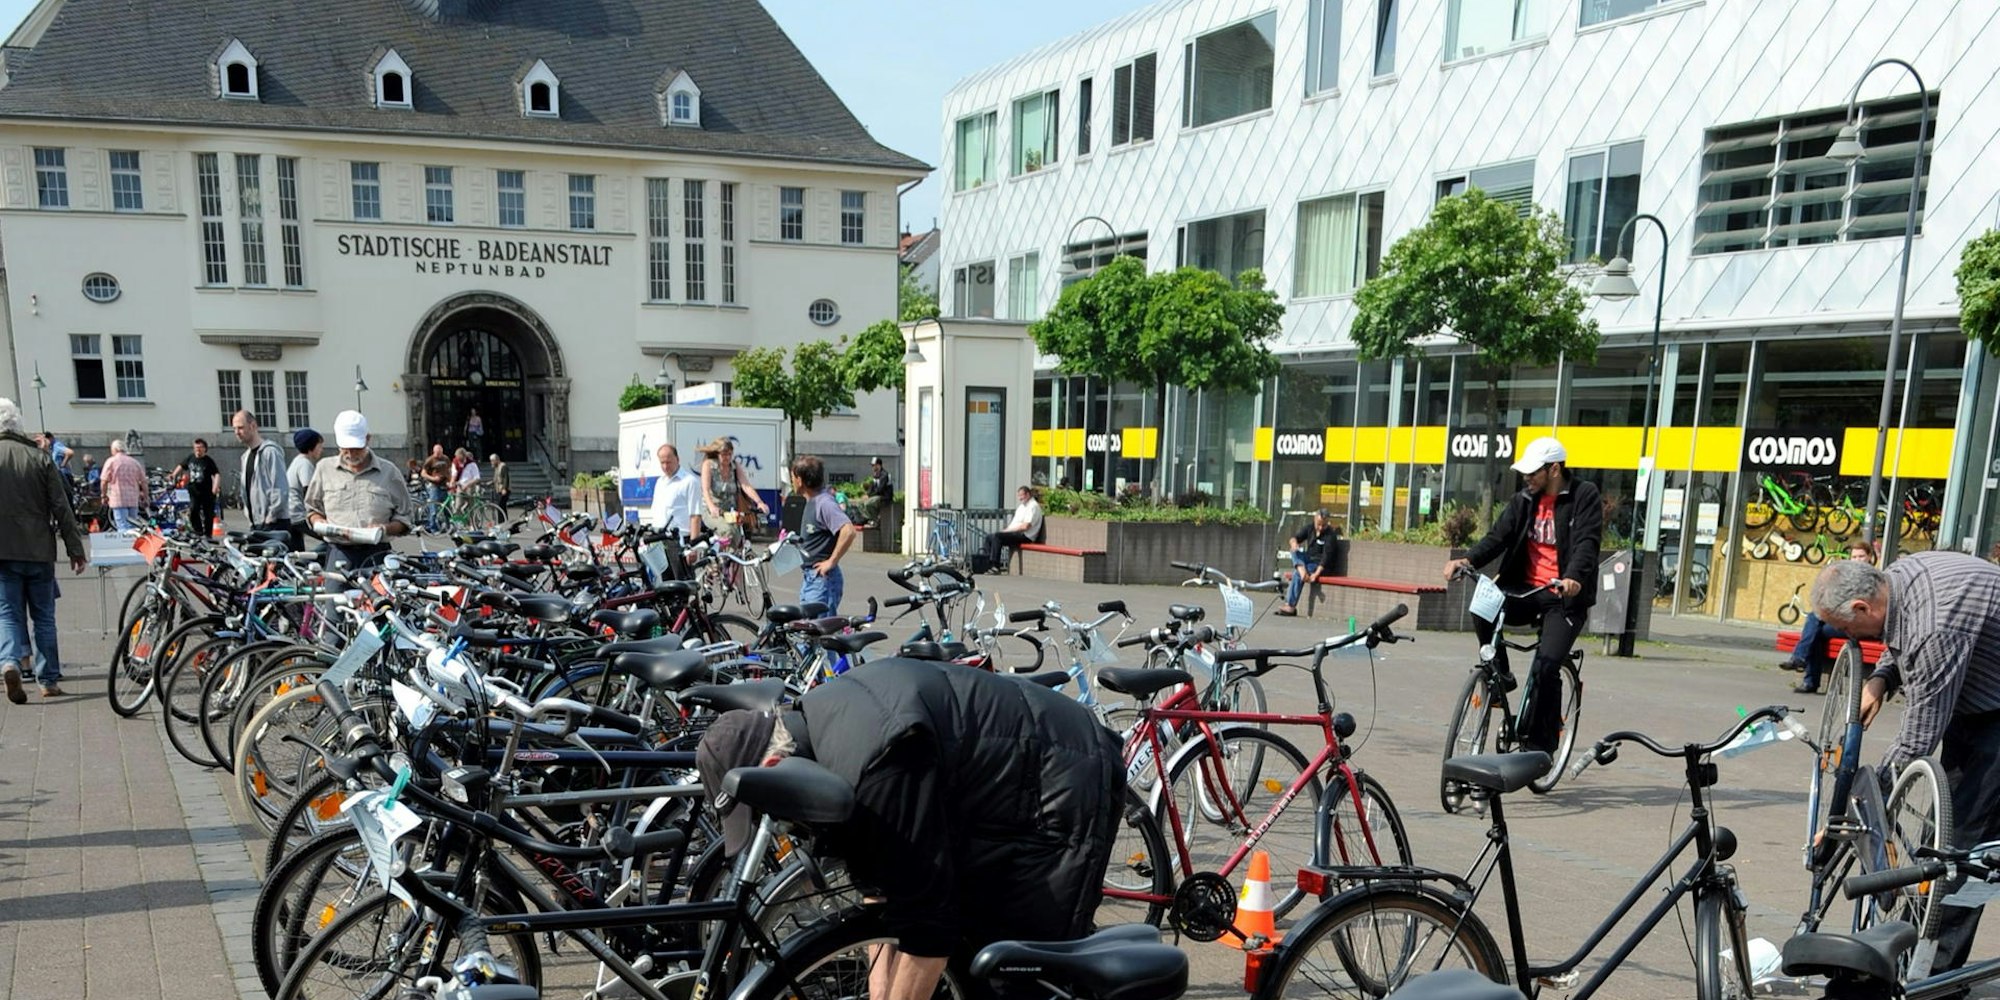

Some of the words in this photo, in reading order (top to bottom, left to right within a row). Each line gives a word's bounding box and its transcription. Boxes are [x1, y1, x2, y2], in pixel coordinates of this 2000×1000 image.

[479, 240, 613, 266] BADEANSTALT
[416, 260, 545, 278] NEPTUNBAD
[1276, 433, 1324, 455] COSMOS
[1748, 436, 1836, 466] COSMOS
